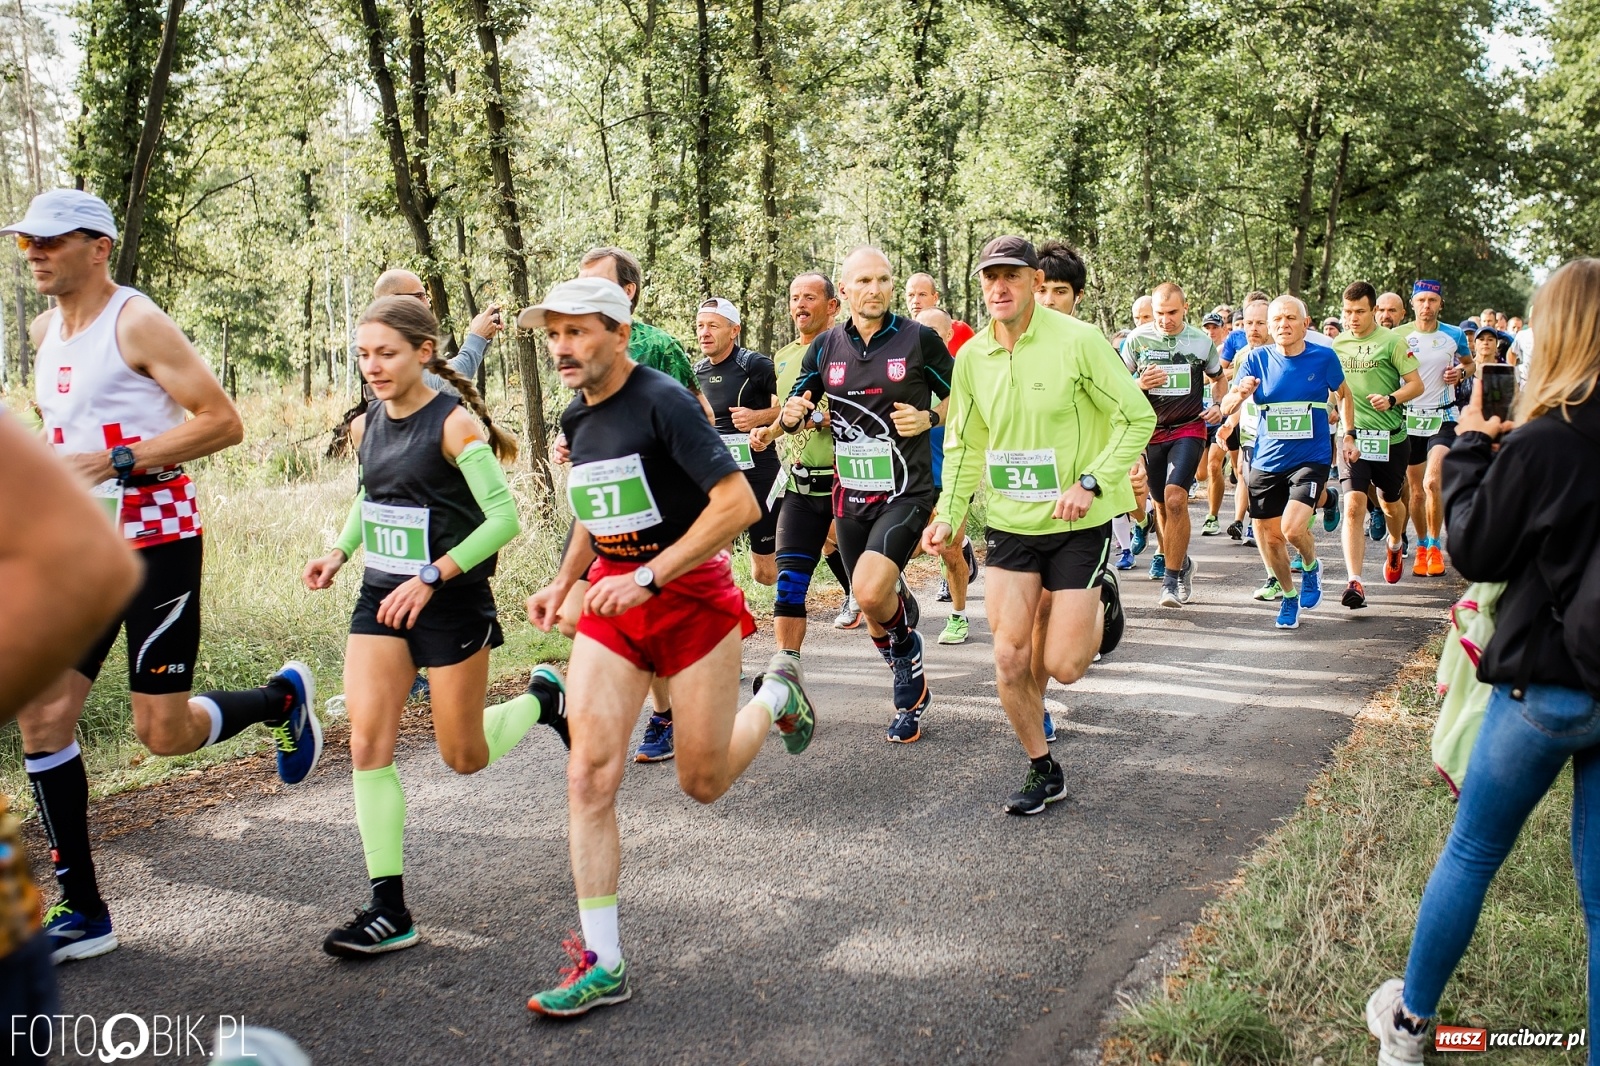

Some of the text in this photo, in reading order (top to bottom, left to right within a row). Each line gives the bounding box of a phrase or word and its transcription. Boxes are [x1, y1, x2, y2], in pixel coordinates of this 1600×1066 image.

[1275, 416, 1302, 431] 137
[1416, 418, 1433, 430] 27
[1356, 440, 1380, 453] 163
[849, 458, 874, 479] 111
[1005, 467, 1039, 489] 34
[586, 484, 621, 518] 37
[374, 526, 409, 557] 110
